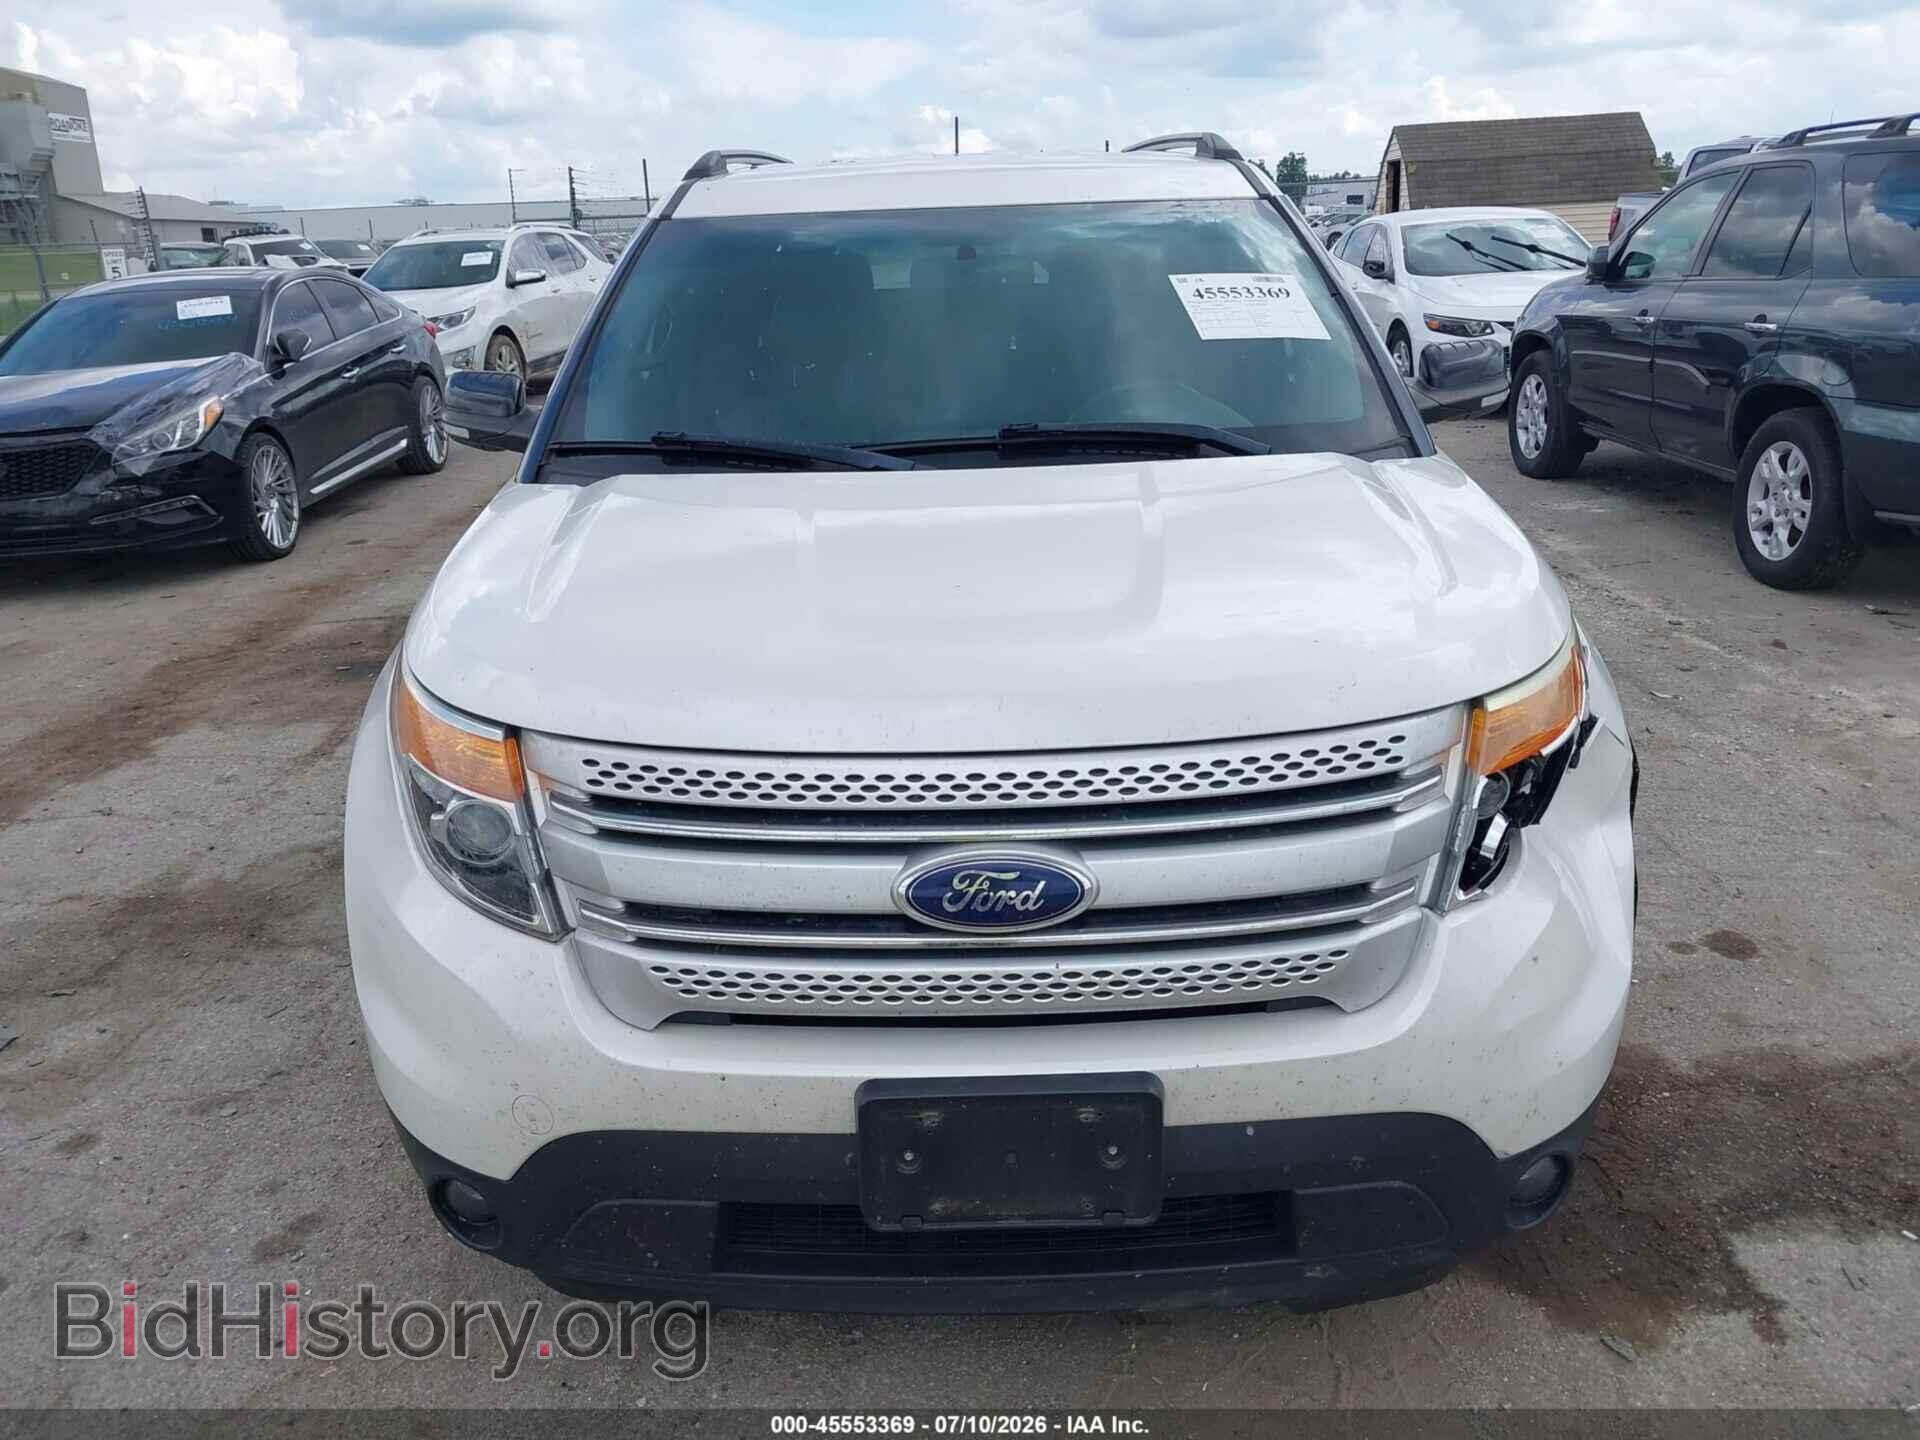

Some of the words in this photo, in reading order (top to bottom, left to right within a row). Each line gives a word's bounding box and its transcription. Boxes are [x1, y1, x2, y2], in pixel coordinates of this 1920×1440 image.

[111, 266, 122, 279] 5
[1192, 286, 1290, 300] 45553369
[942, 869, 1046, 913] Ford
